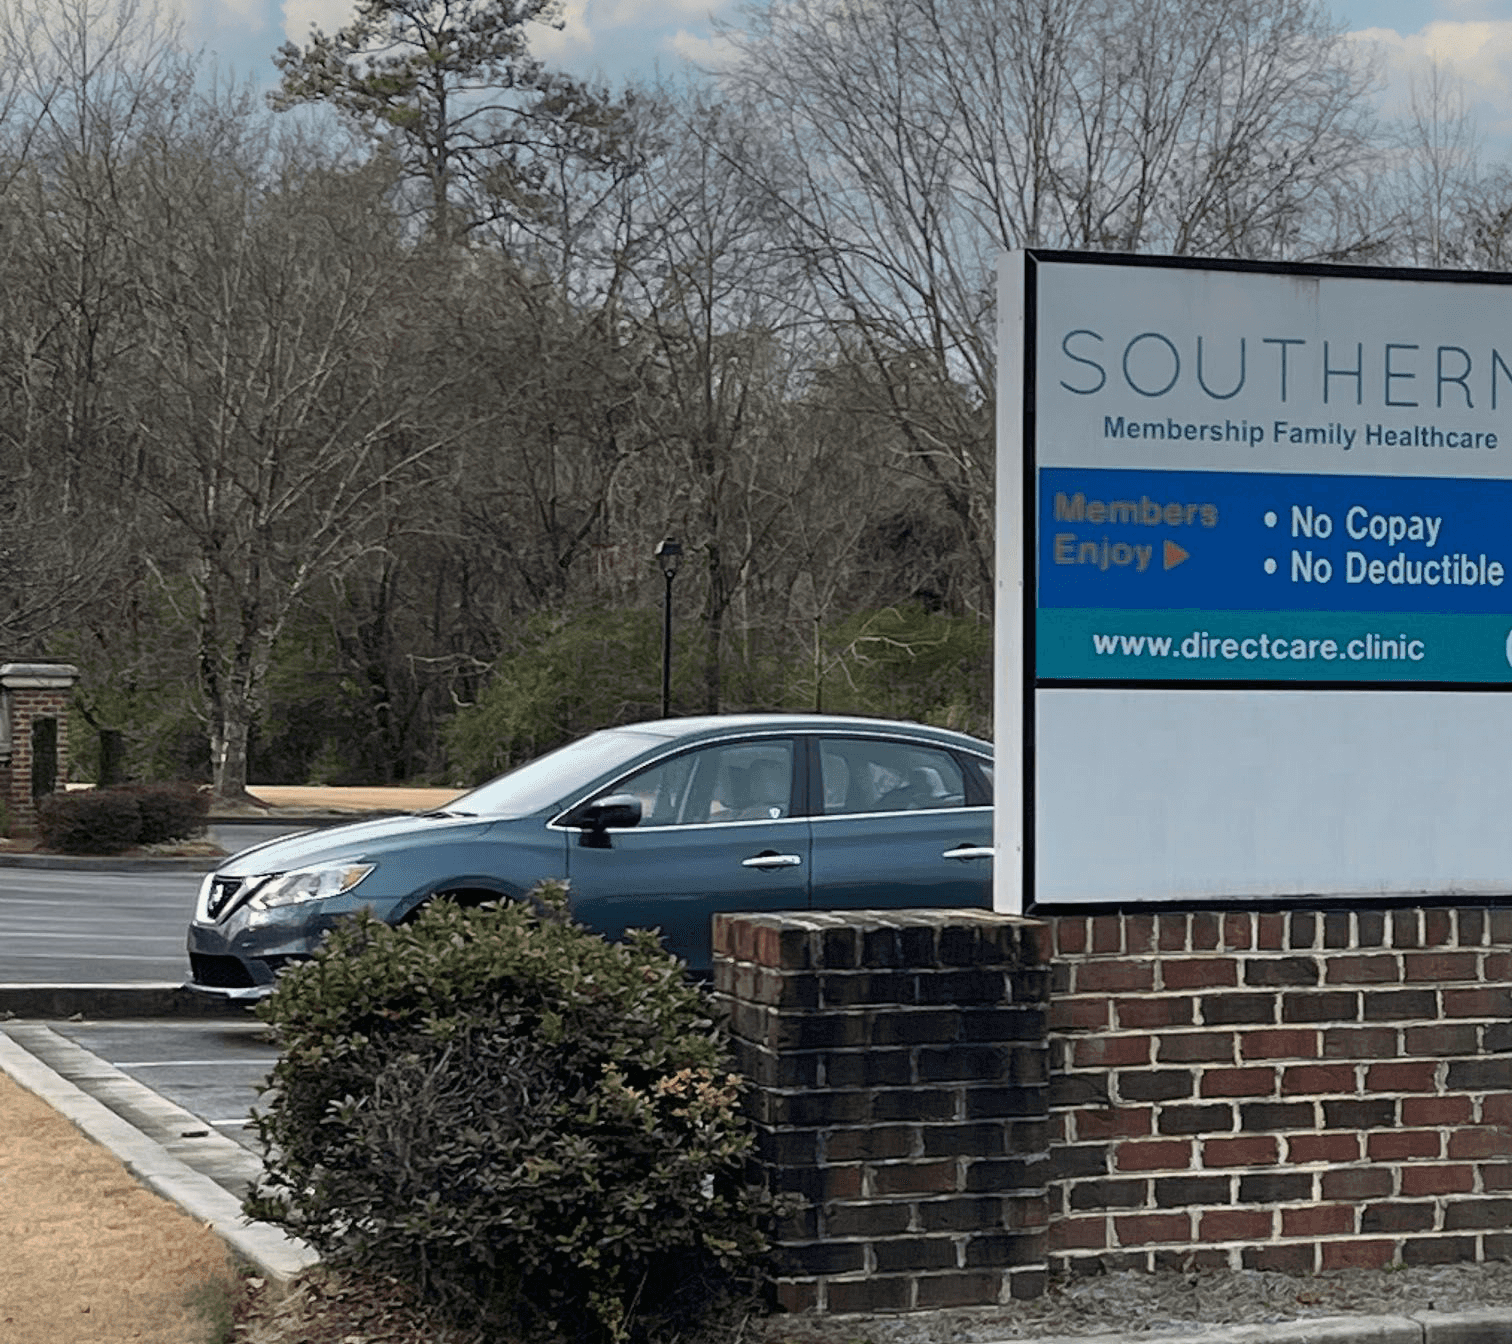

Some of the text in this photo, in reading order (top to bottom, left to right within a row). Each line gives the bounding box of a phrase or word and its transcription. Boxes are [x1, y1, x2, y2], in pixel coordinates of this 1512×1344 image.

[1103, 415, 1498, 451] Membership Family Healthcare
[1053, 492, 1219, 528] Members
[1291, 505, 1442, 548] No Copay
[1053, 533, 1153, 572] Enjoy
[1291, 550, 1505, 586] No Deductible
[1092, 631, 1425, 661] www.directcare.clinic
